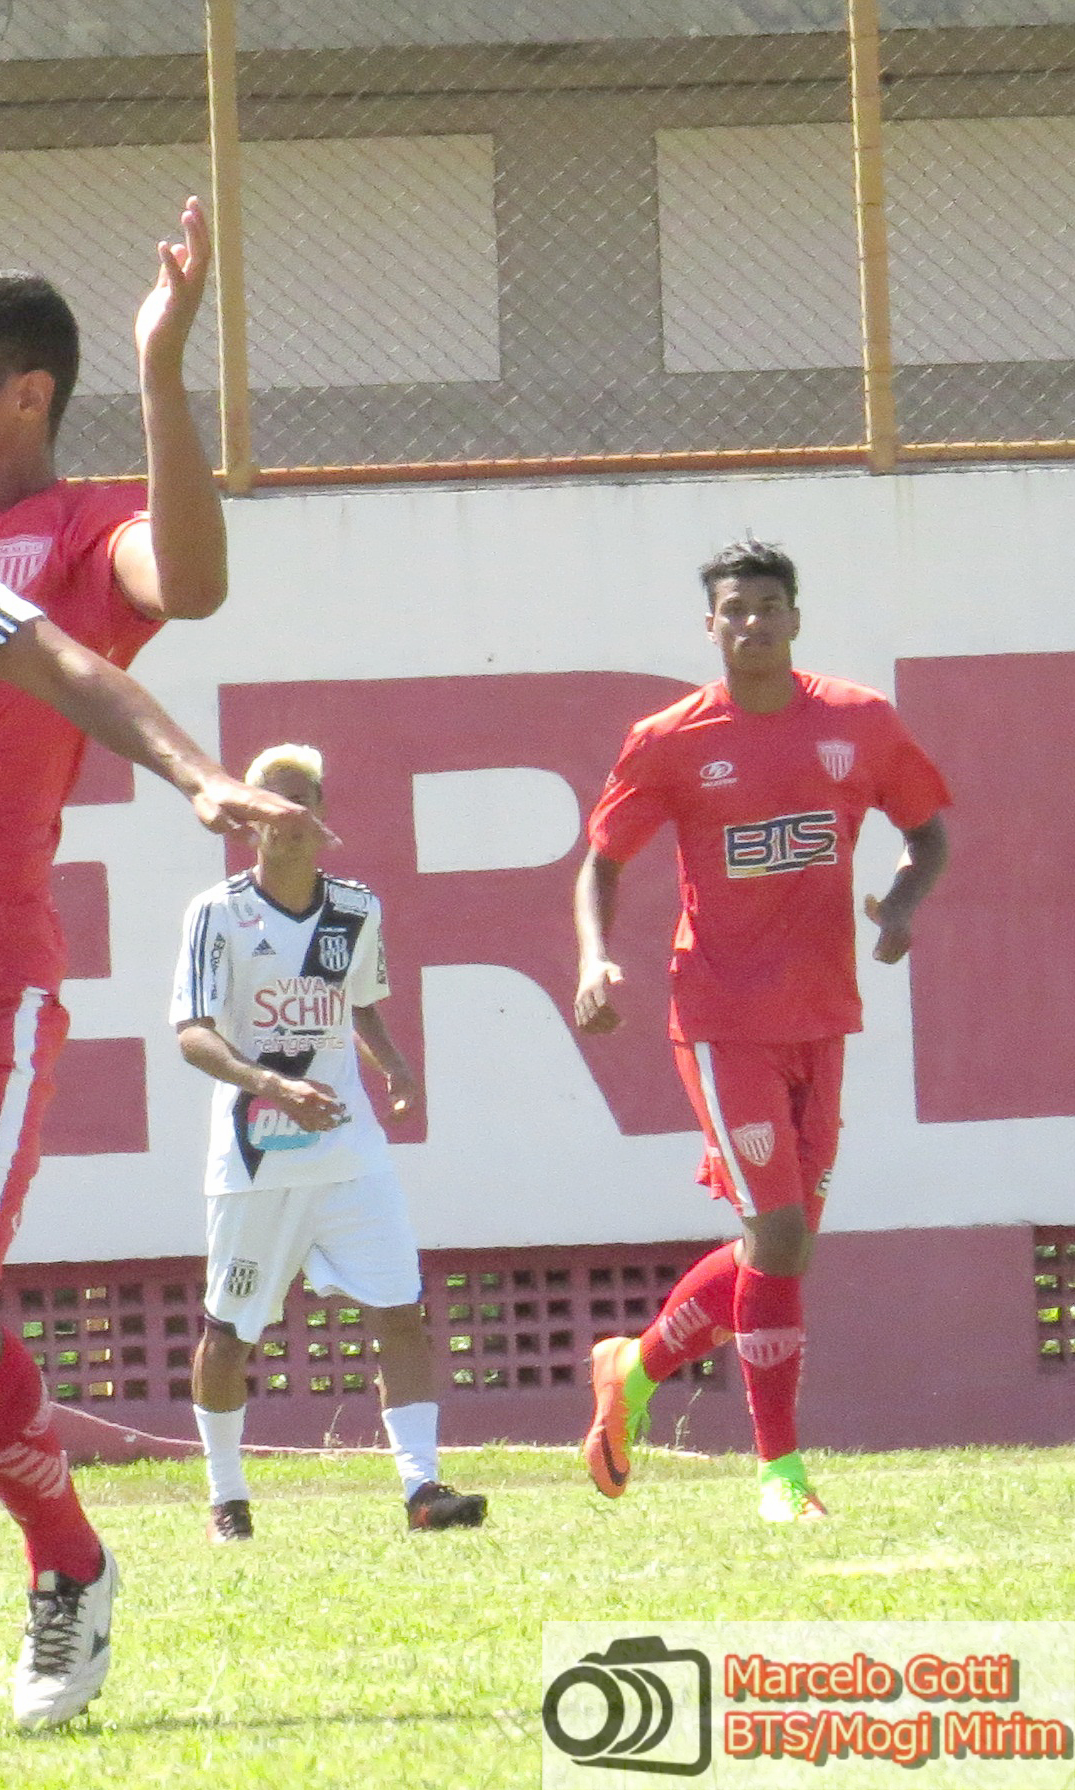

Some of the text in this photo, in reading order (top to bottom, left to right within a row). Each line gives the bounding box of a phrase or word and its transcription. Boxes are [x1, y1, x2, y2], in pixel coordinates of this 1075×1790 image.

[725, 811, 837, 876] BTS
[277, 978, 327, 996] VIVA
[252, 988, 346, 1028] SCHIN
